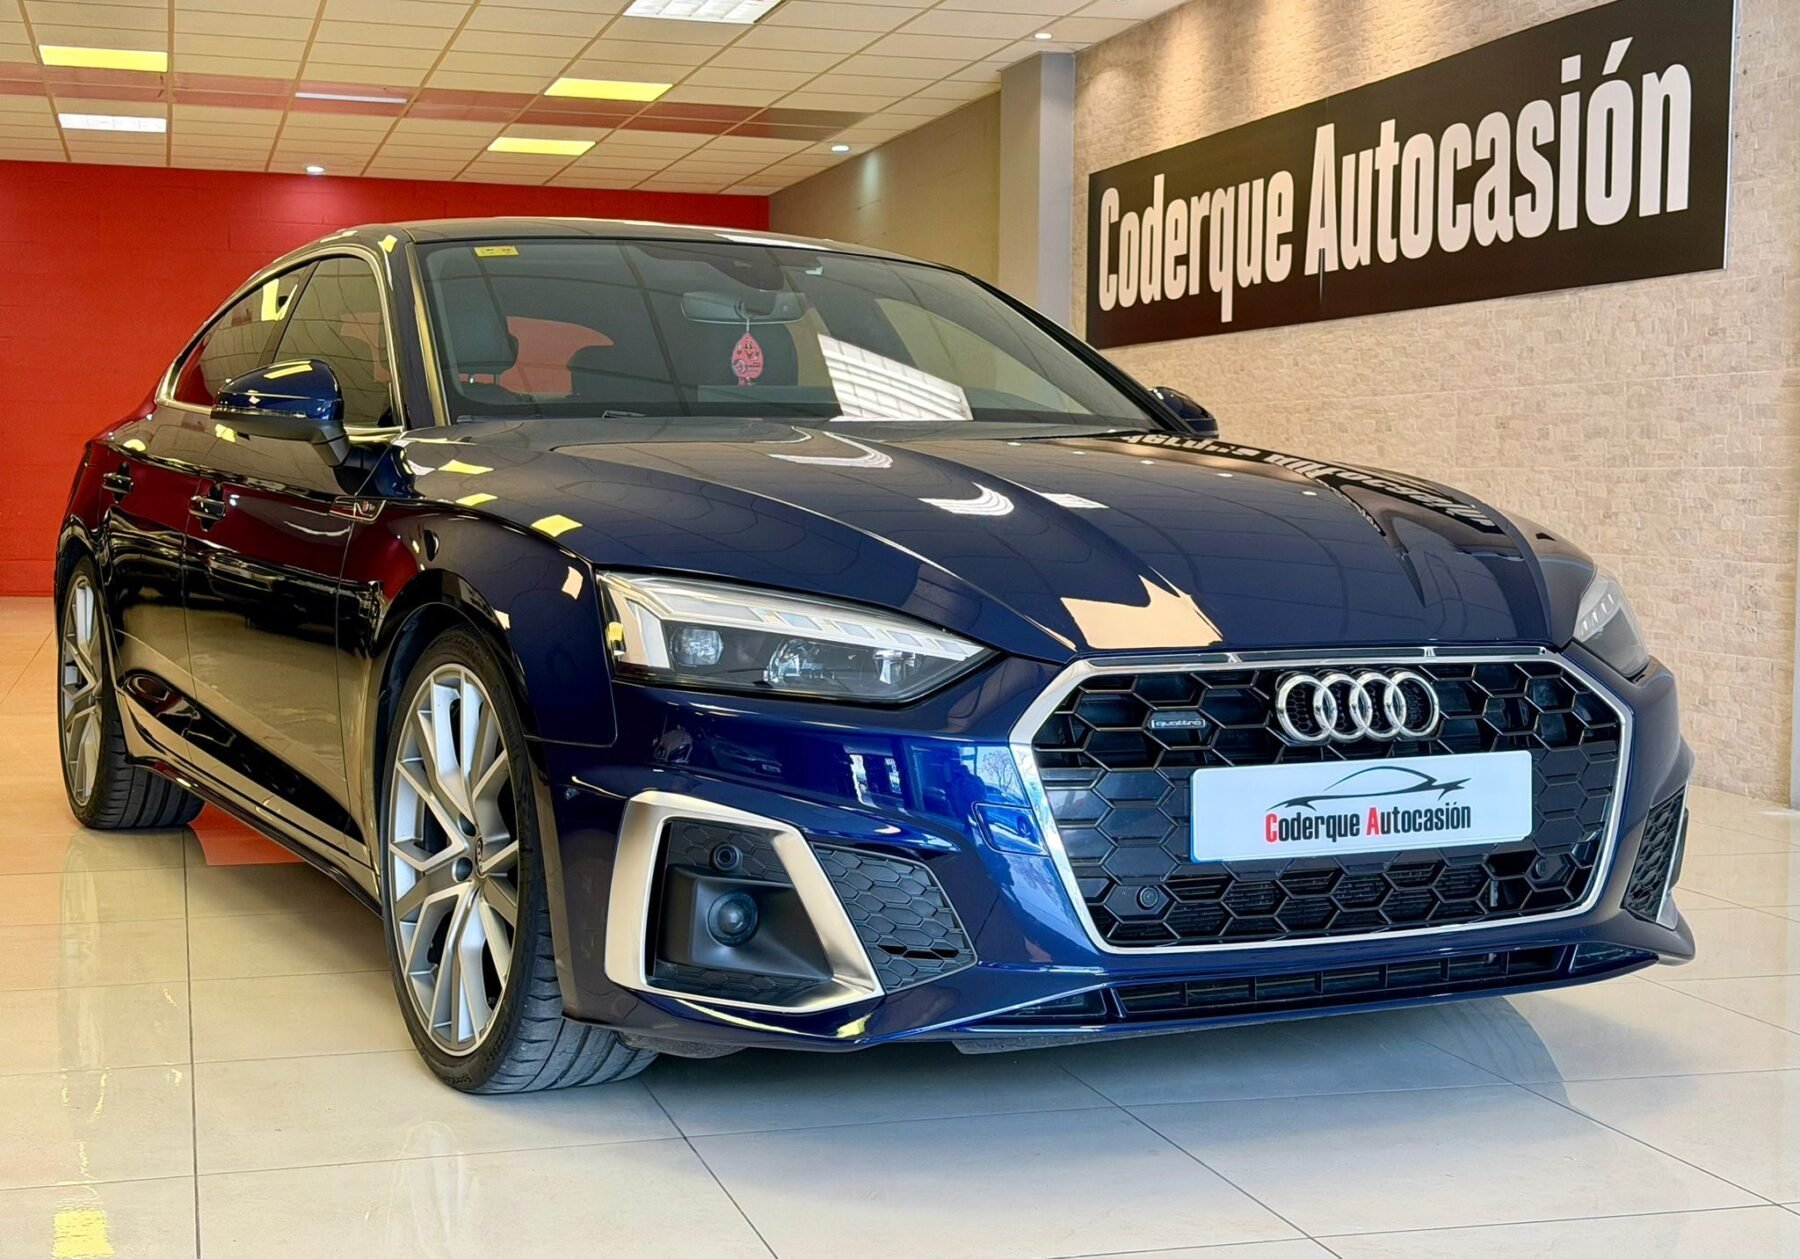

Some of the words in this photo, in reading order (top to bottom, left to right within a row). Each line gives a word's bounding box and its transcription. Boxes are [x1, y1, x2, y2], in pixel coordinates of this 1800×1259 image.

[1099, 170, 1293, 323] Coderque
[1304, 37, 1692, 276] Autocasión
[1265, 812, 1360, 843] Coderque
[1366, 802, 1471, 836] Autocasión
